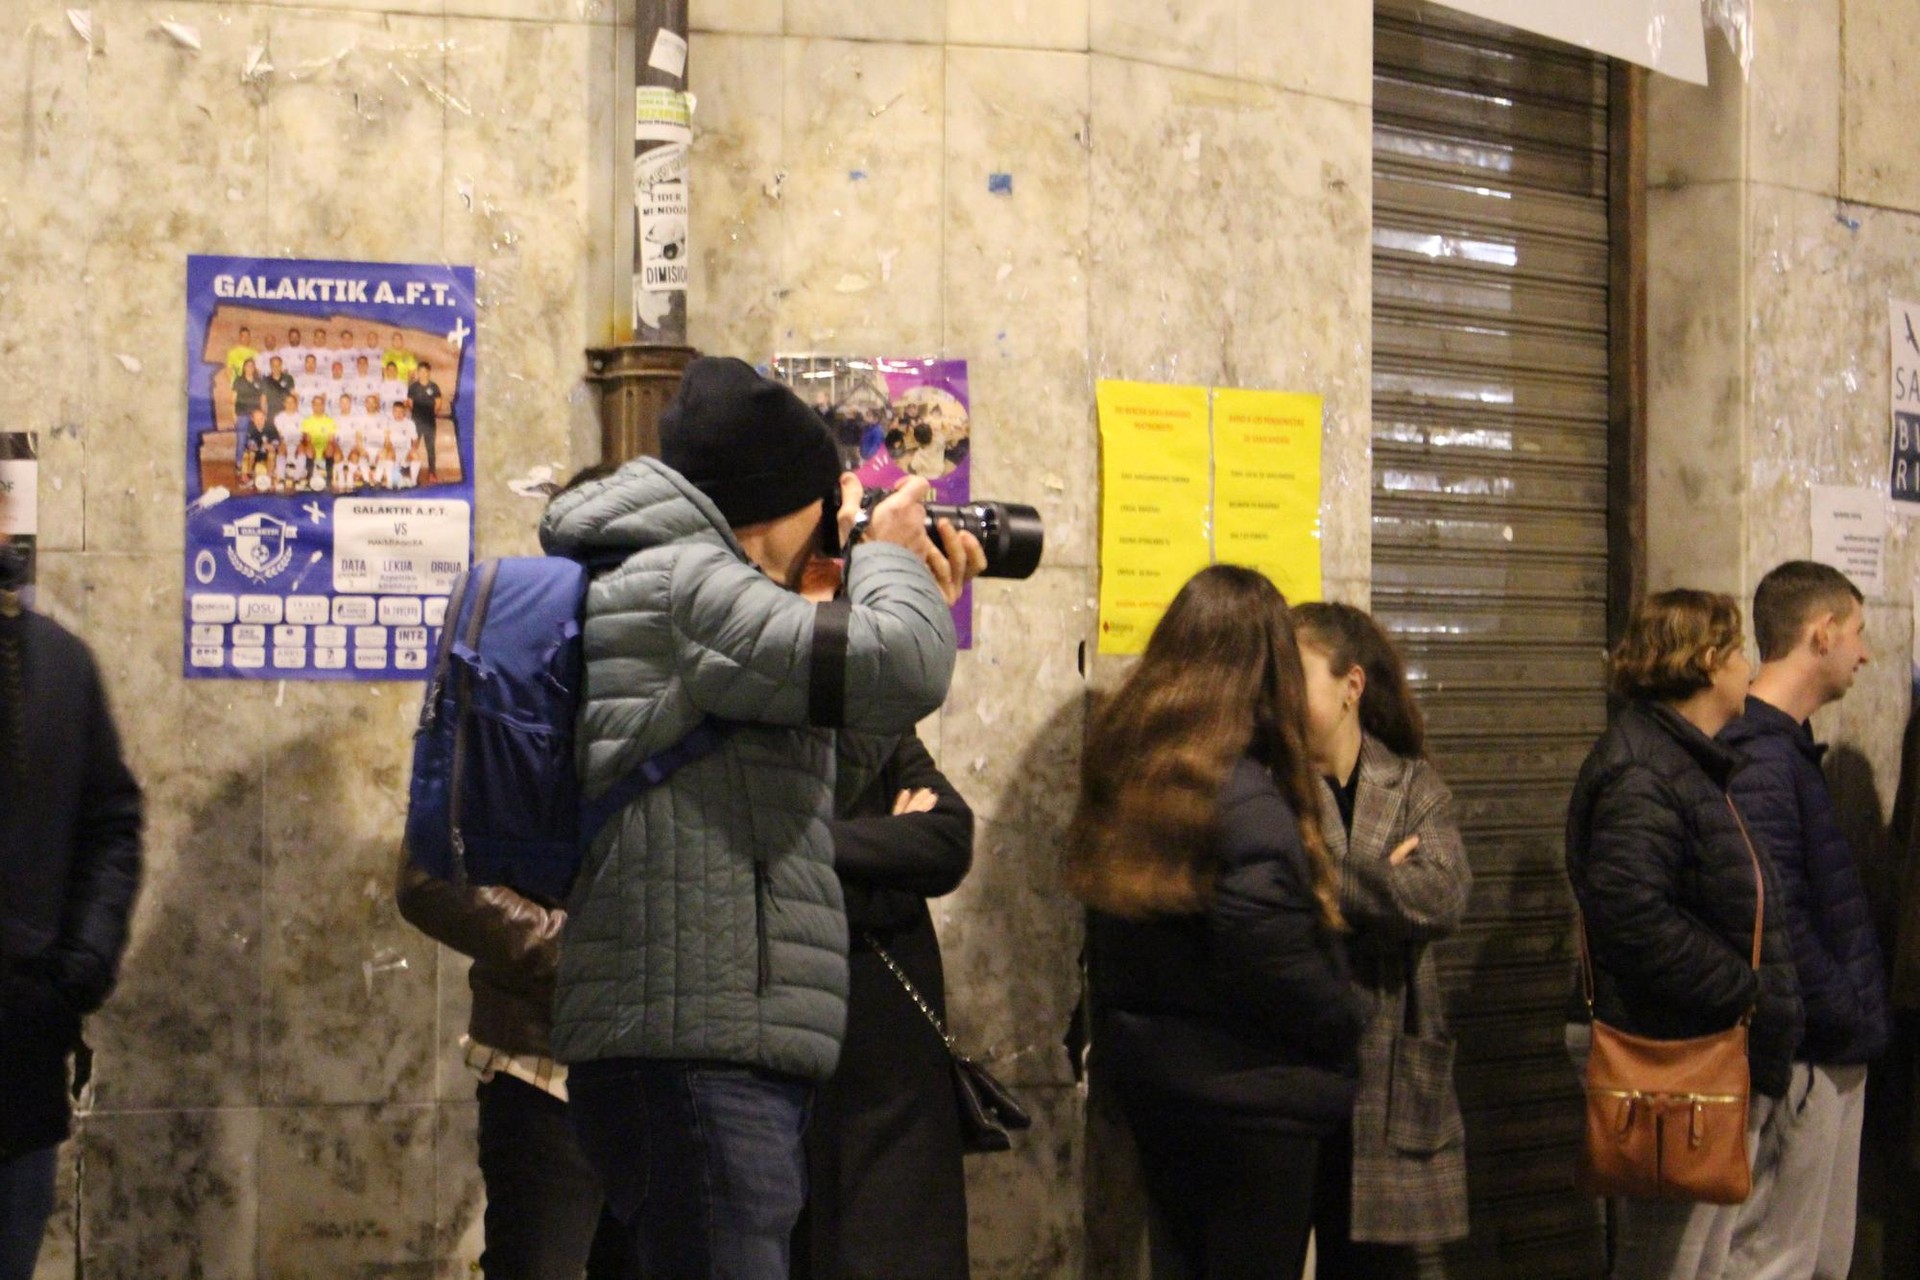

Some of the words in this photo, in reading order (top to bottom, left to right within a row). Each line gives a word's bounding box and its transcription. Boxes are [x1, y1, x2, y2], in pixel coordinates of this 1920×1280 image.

[213, 273, 368, 303] GALAKTIK
[373, 280, 457, 307] A.F.T.
[353, 505, 412, 515] GALAKTIK
[393, 522, 408, 536] VS
[341, 559, 366, 572] DATA
[383, 560, 413, 573] LEKUA
[430, 561, 462, 574] ORDUA
[245, 602, 276, 617] JOSU
[399, 630, 424, 641] INTZ
